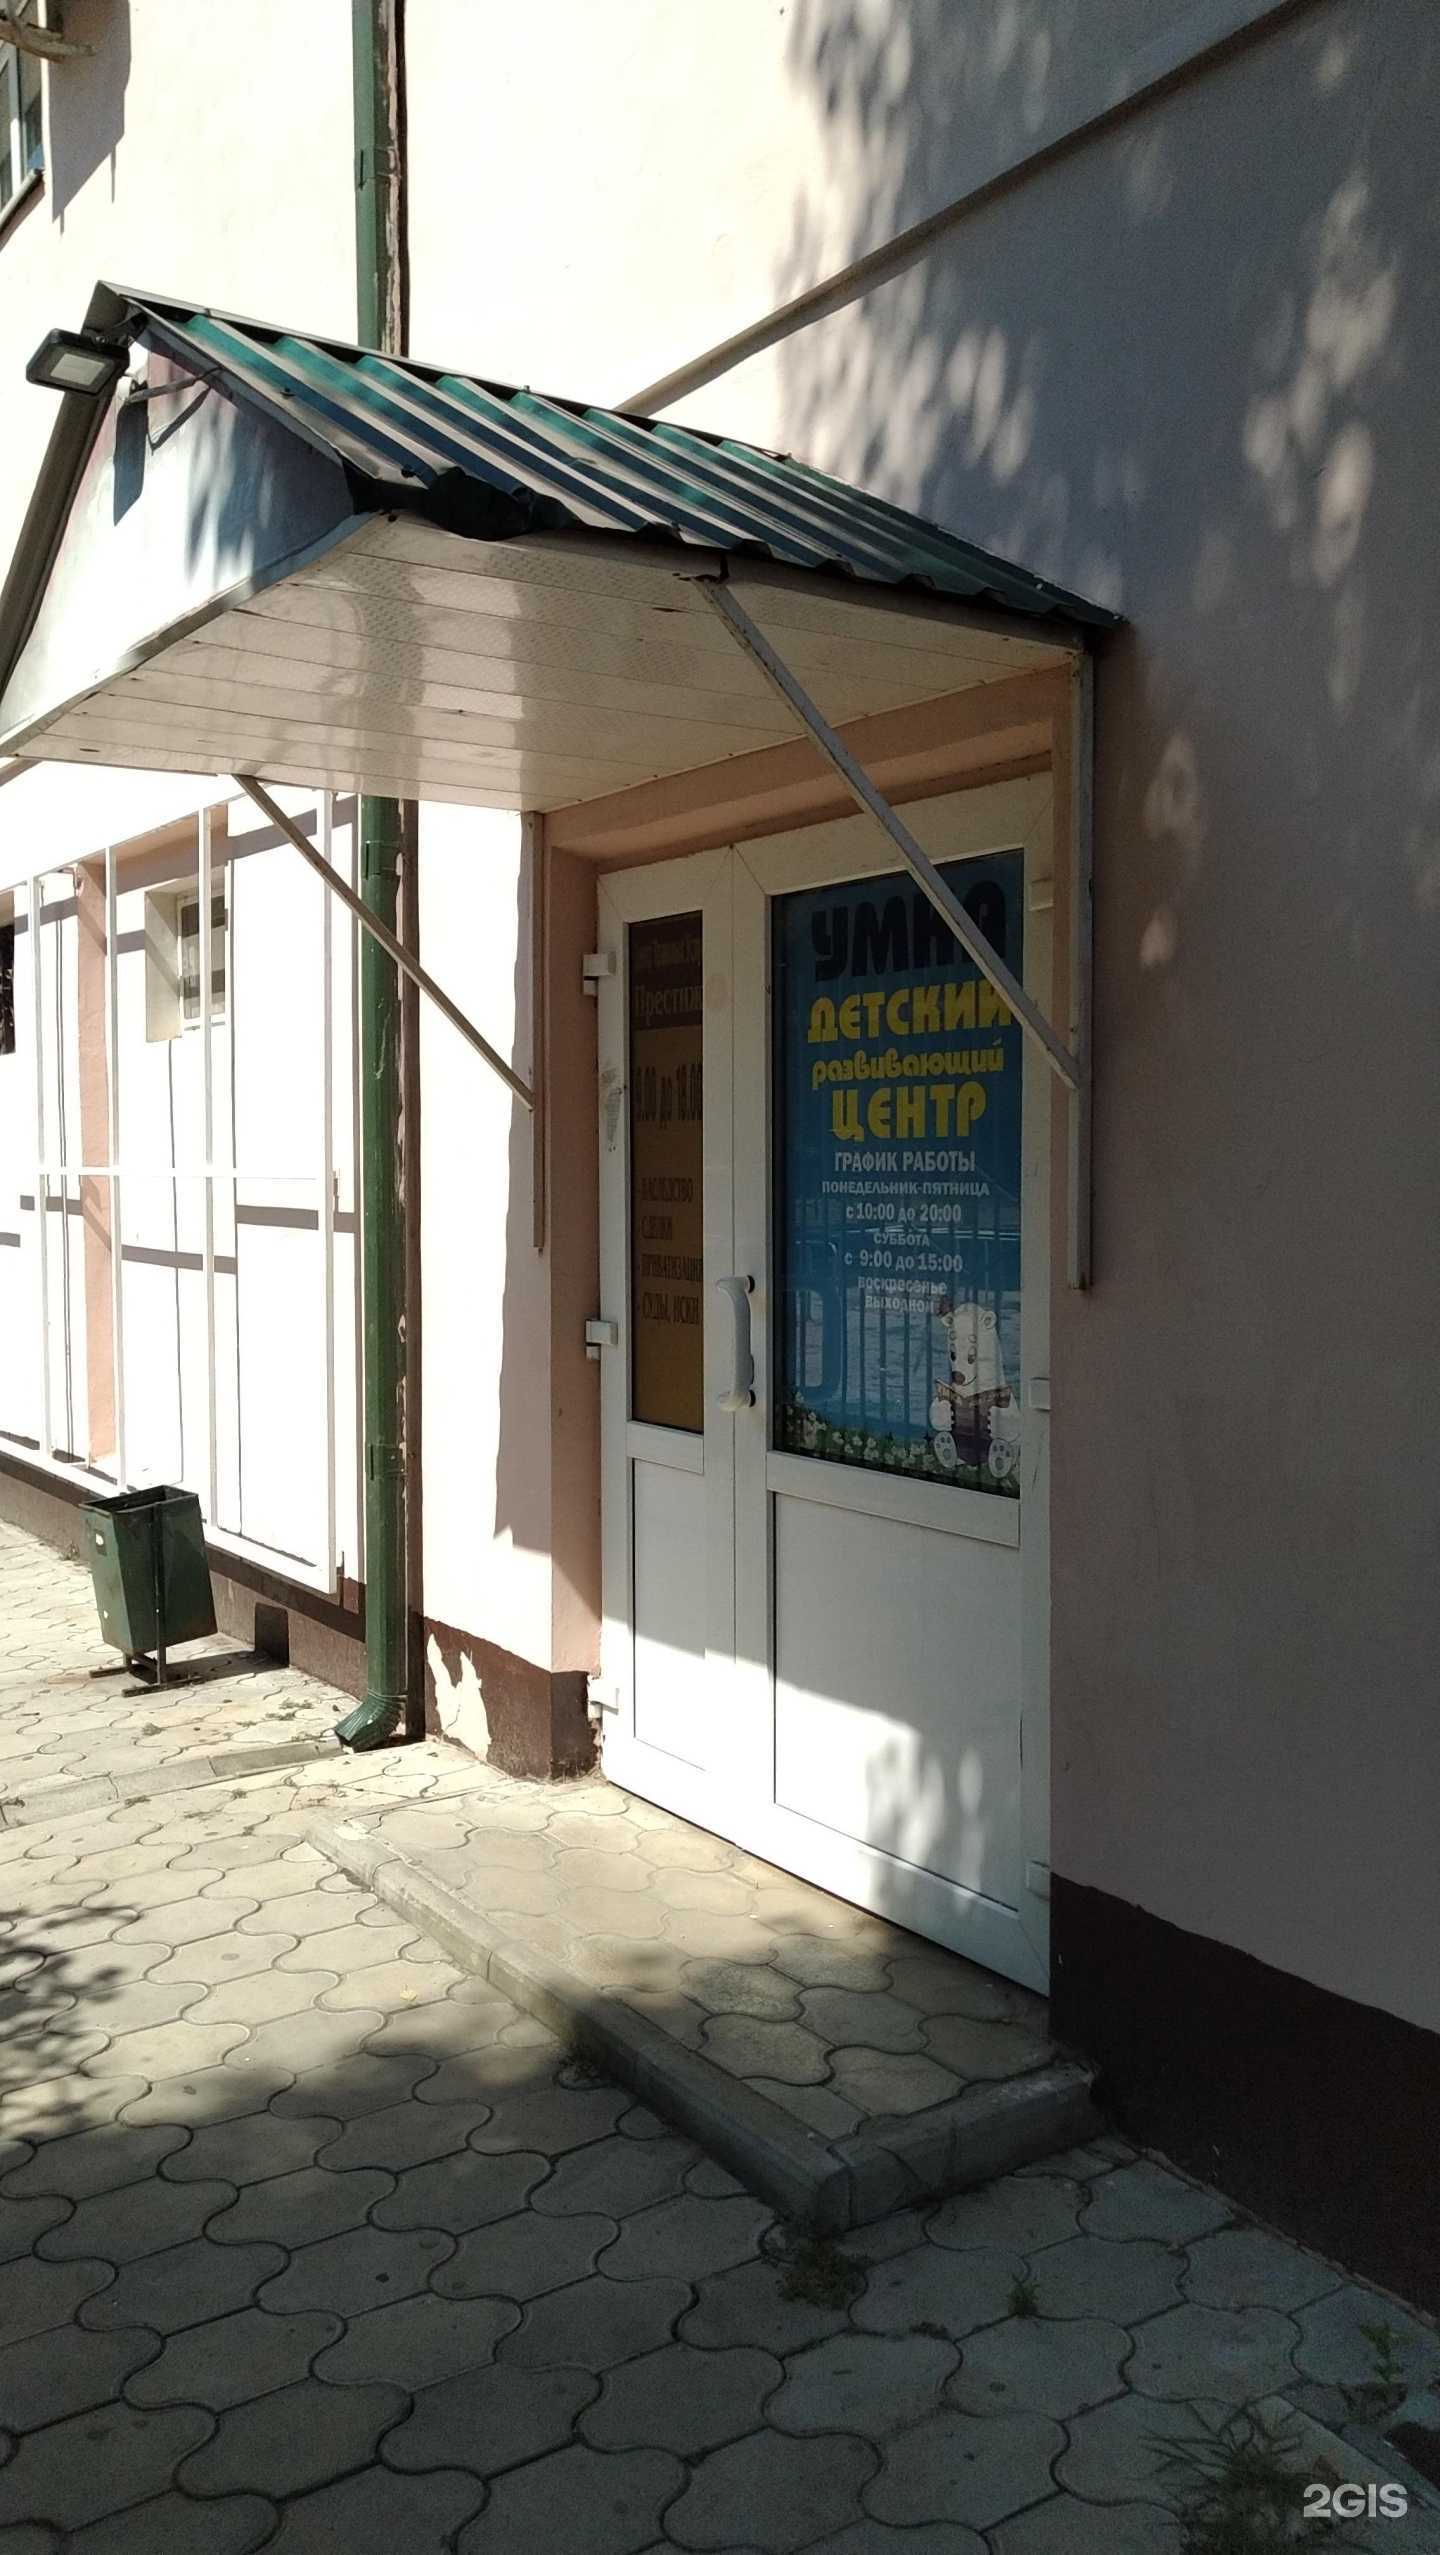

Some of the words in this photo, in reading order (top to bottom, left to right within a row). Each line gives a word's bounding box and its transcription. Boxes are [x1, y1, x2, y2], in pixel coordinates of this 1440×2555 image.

[811, 1037, 1004, 1090] развивающий
[831, 1081, 987, 1142] ЦЕНТР
[834, 1151, 896, 1172] ГРАФИК
[902, 1151, 975, 1173] РАБОТЫ
[822, 1180, 990, 1197] ПОНЕДЕЛЬНИК-ПЯТНИЦА
[856, 1203, 895, 1221] 10:00
[897, 1208, 916, 1224] до
[919, 1204, 962, 1222] 20:00
[873, 1232, 931, 1248] СУББОТА
[859, 1249, 893, 1268] 9:00
[895, 1255, 915, 1271] до
[918, 1253, 963, 1272] 15:00
